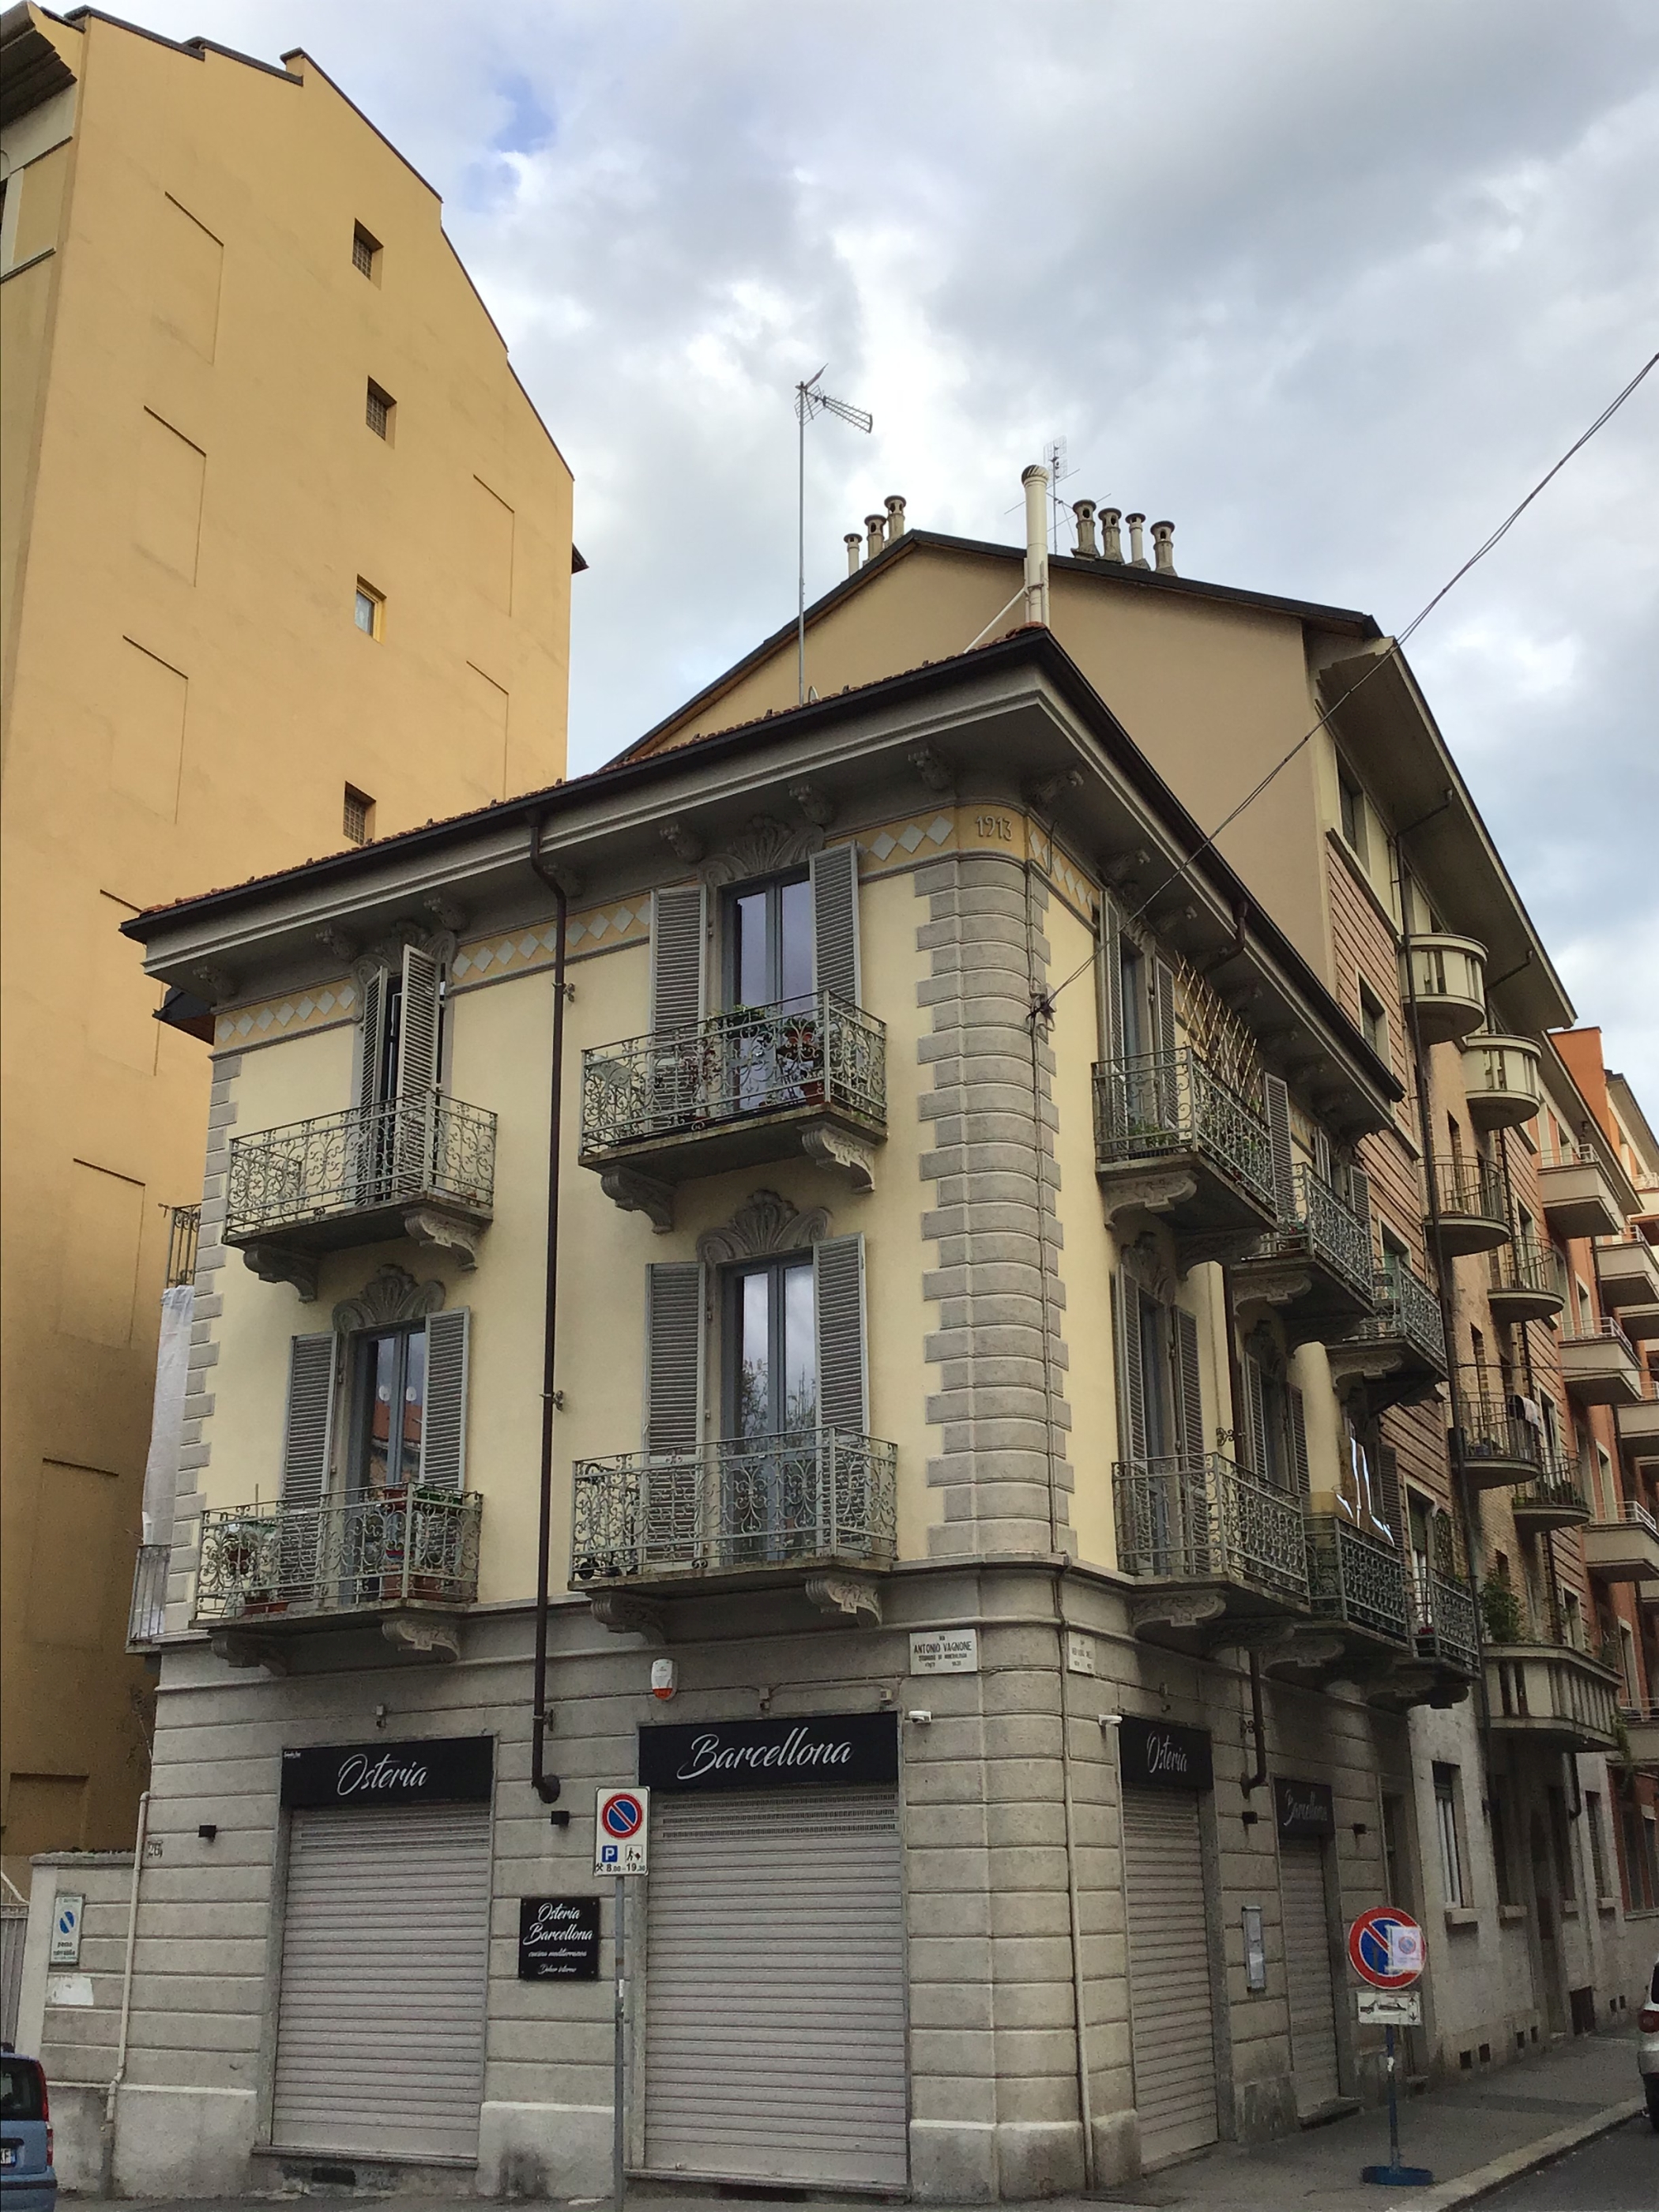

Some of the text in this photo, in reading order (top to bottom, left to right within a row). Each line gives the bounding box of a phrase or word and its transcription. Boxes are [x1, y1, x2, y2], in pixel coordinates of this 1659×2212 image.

[976, 815, 1012, 841] 1913
[914, 1641, 972, 1653] ANTONIO VAGNONE
[676, 1727, 853, 1780] Barcellona
[1146, 1730, 1187, 1774] Osteria
[337, 1753, 427, 1796] Osteria
[605, 1848, 615, 1860] P
[538, 1902, 580, 1922] Osteria
[523, 1922, 593, 1946] Barcellona
